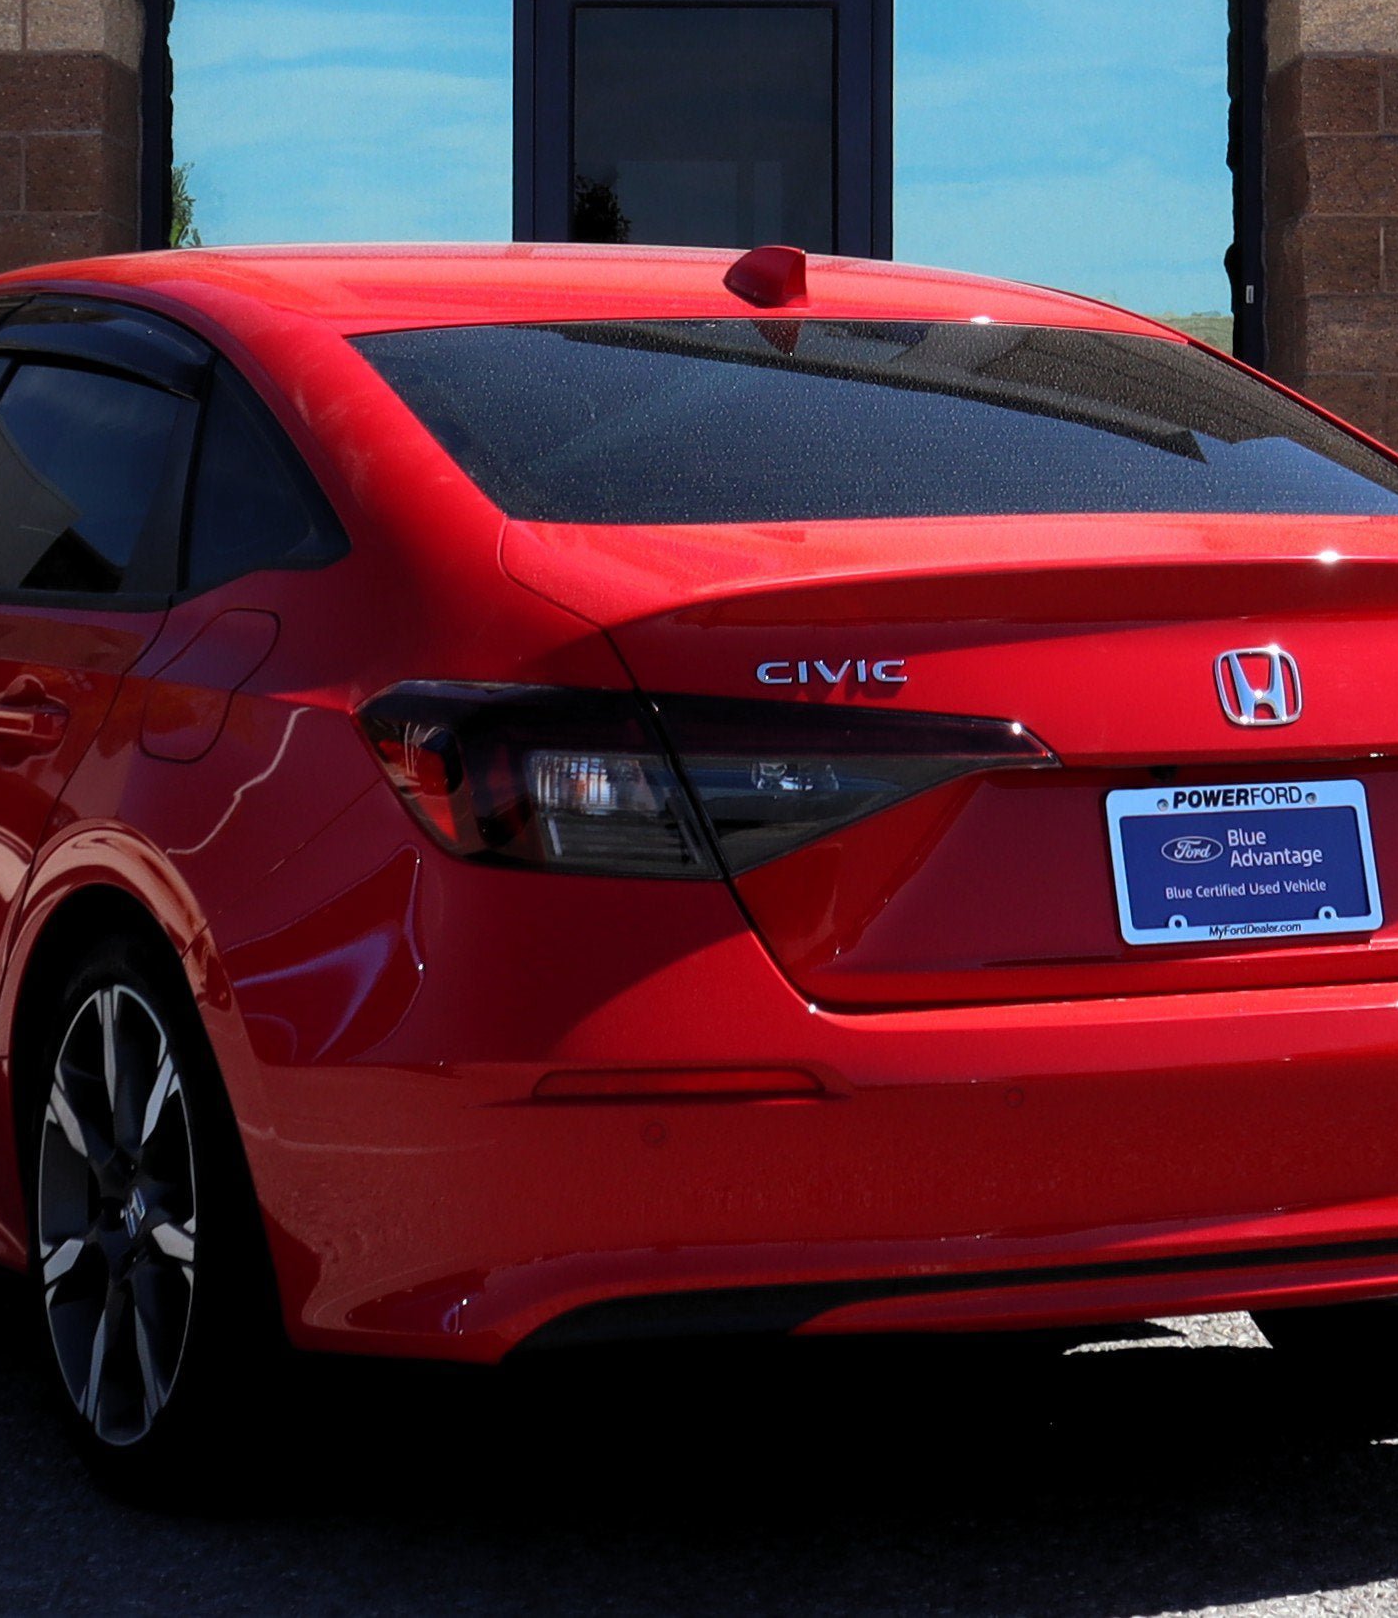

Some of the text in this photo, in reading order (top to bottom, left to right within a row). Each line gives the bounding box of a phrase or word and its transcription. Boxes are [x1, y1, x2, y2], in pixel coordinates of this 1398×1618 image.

[756, 659, 908, 684] CIVIC
[1172, 785, 1303, 809] POWERFORD
[1227, 828, 1267, 846] Blue
[1173, 839, 1212, 860] Ford
[1229, 846, 1323, 868] Advantage
[1165, 878, 1327, 900] Blue Certified Used Vehicle
[1208, 922, 1302, 940] MyFordDealer.com
